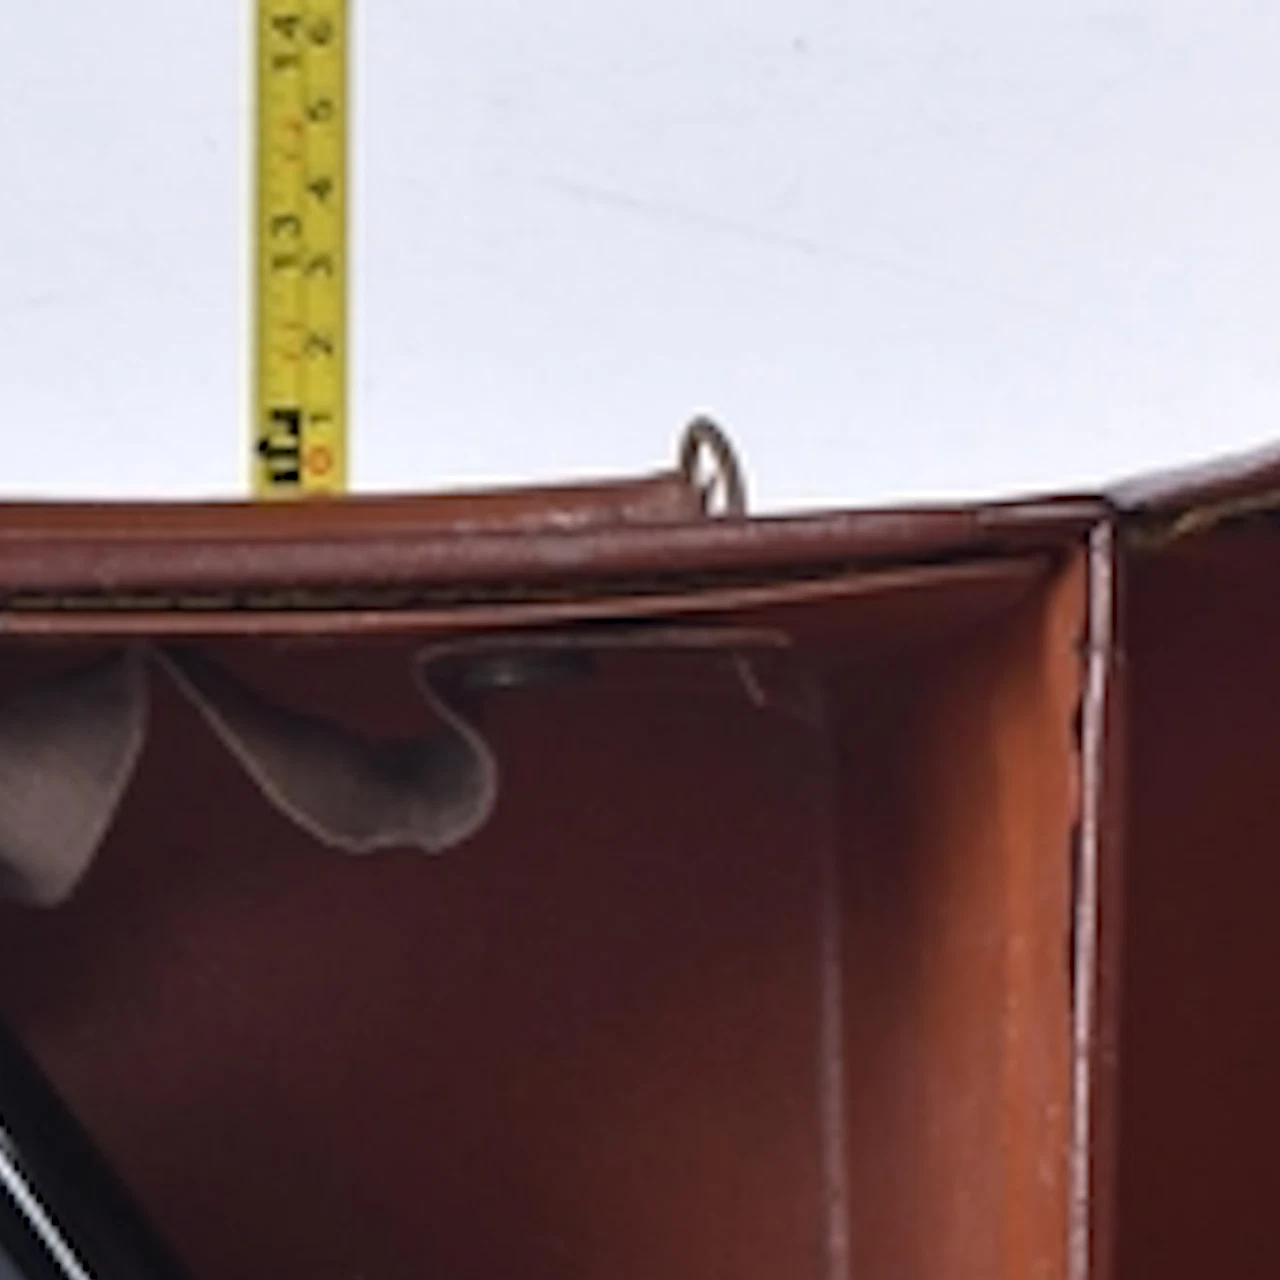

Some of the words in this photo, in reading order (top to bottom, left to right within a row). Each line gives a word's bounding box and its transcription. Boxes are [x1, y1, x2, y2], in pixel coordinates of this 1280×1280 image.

[269, 14, 302, 71] 14
[305, 16, 334, 47] 6
[304, 97, 334, 124] 5
[305, 175, 334, 204] 4
[269, 213, 302, 271] 13
[302, 253, 334, 278] 3
[302, 332, 334, 359] 2
